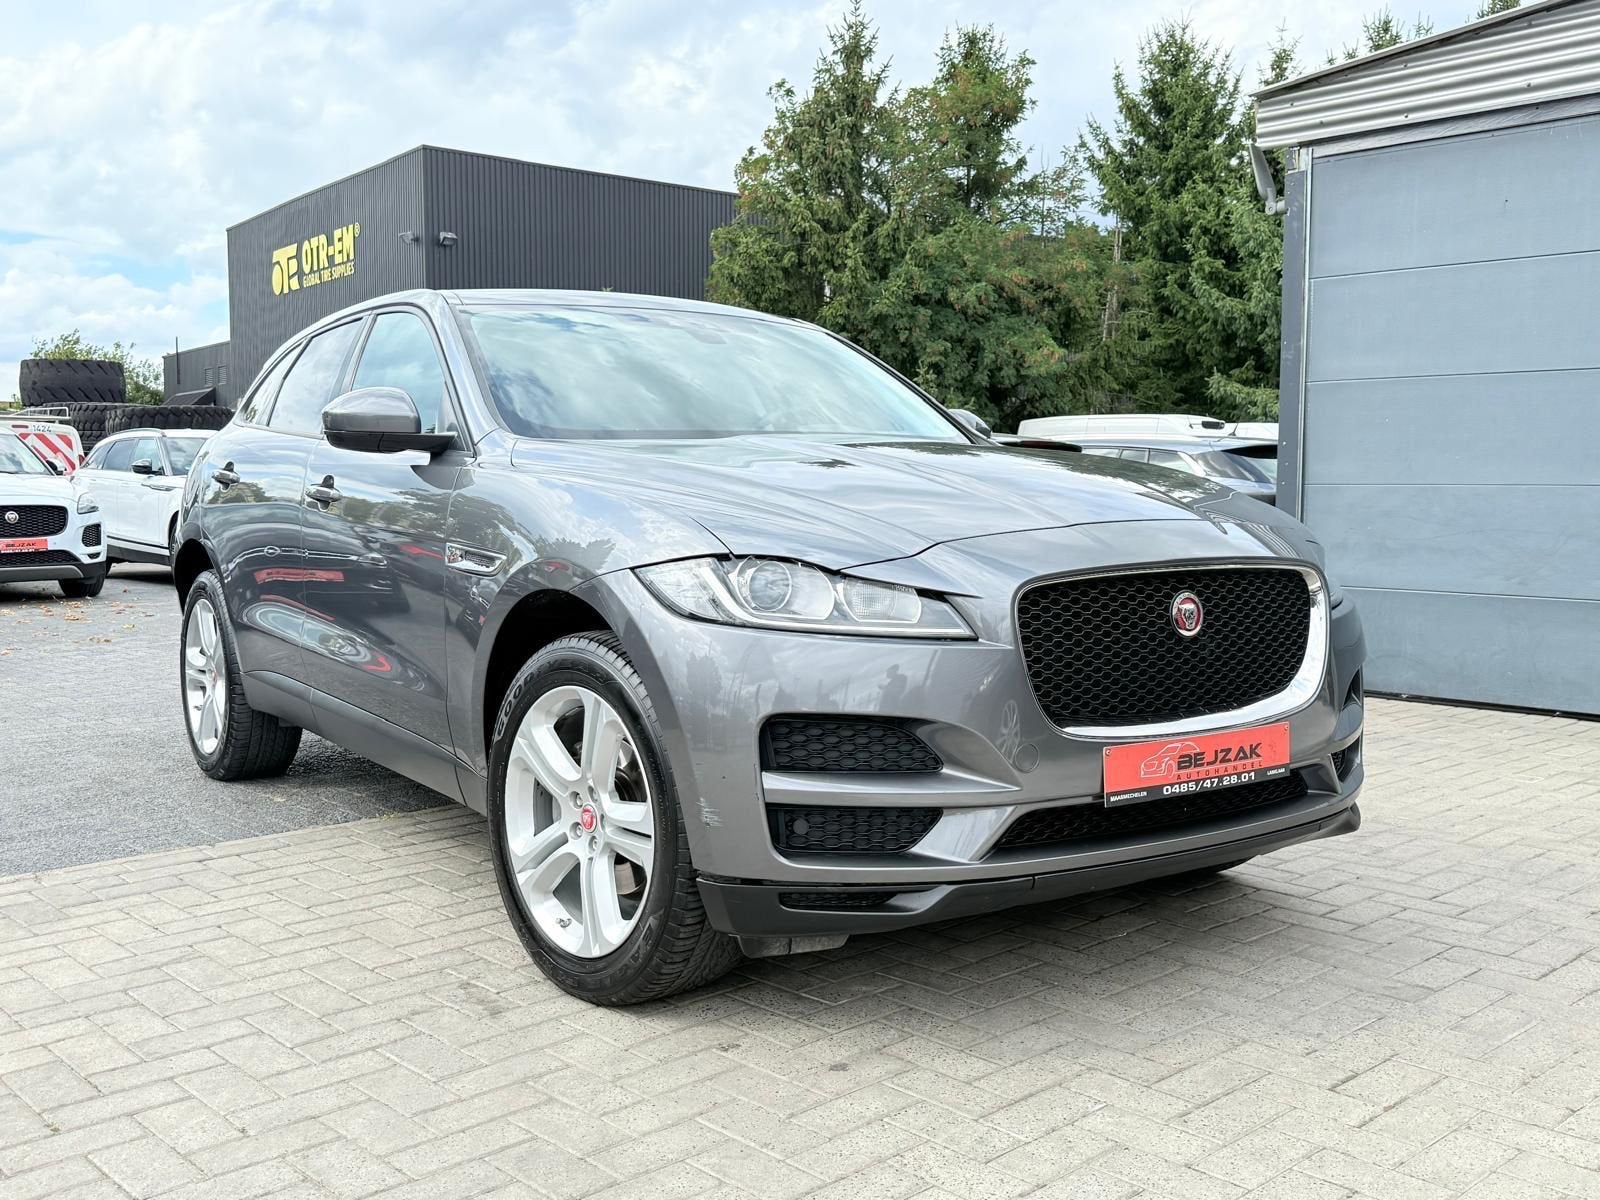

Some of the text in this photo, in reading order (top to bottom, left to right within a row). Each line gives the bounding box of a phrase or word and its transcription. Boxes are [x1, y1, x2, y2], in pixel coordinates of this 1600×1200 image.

[1177, 742, 1262, 770] BEJZAK
[1176, 762, 1263, 780] AUTOHANDEL
[1163, 772, 1255, 795] 0485/47.28.01
